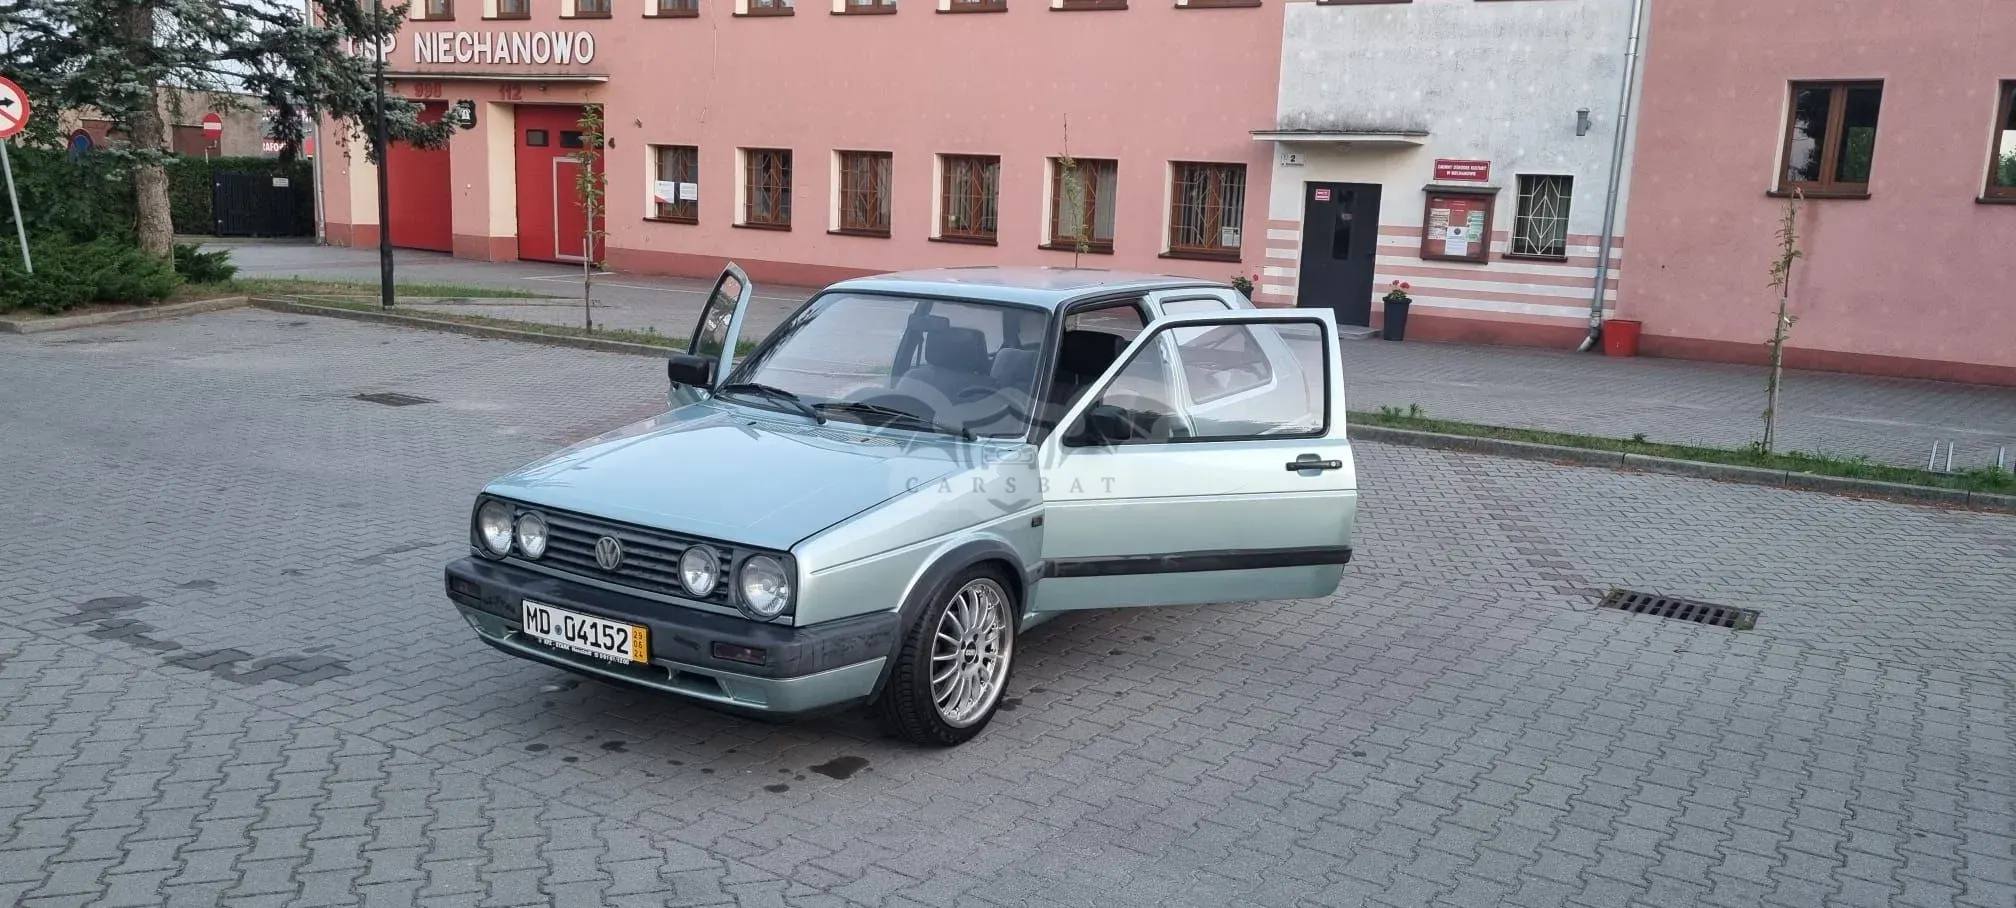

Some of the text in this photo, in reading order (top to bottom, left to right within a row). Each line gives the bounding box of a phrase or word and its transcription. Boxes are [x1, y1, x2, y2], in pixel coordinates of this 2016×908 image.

[414, 31, 595, 64] NIECHANOWO
[499, 84, 522, 100] 112
[1290, 154, 1296, 163] 2
[526, 604, 629, 655] MD 04152
[633, 630, 643, 640] 29
[633, 649, 643, 658] 24
